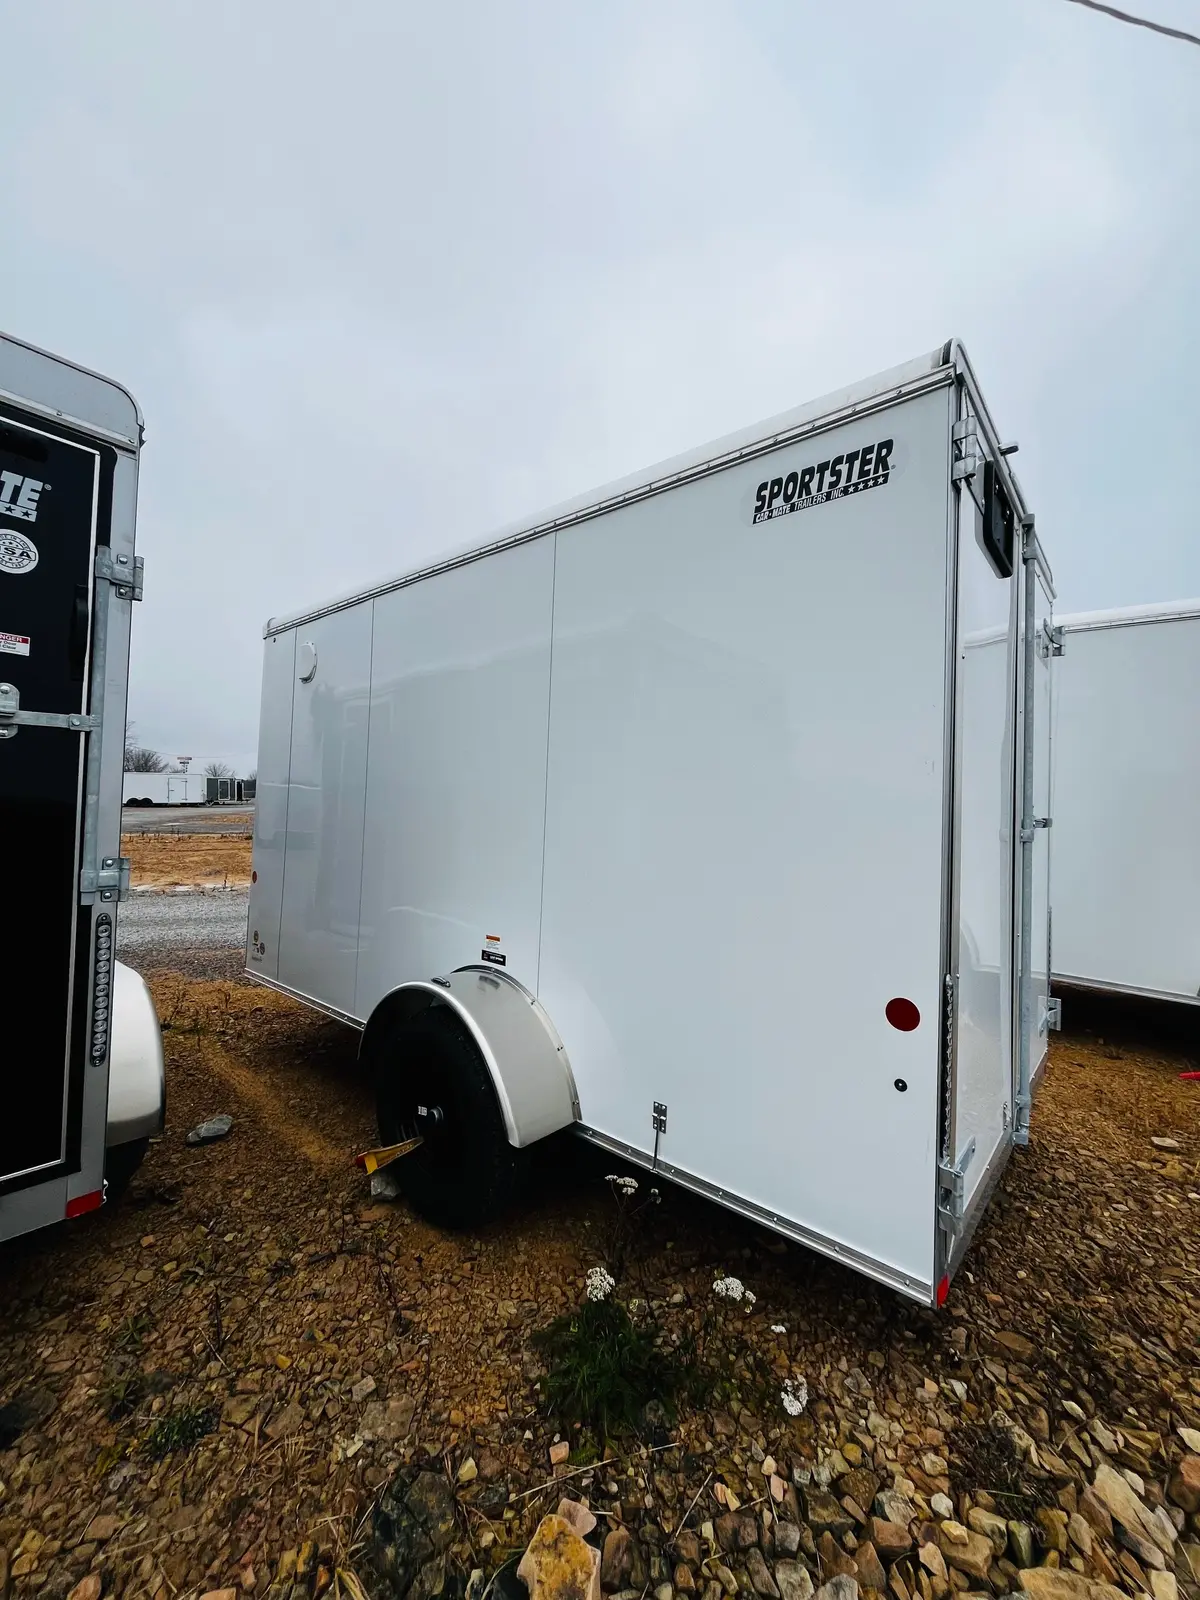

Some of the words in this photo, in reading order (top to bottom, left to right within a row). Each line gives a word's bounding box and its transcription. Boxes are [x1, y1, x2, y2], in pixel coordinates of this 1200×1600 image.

[754, 439, 894, 513] SPORTSTER
[794, 492, 827, 511] TRAILERS
[830, 487, 845, 500] INC.
[0, 546, 32, 560] SA
